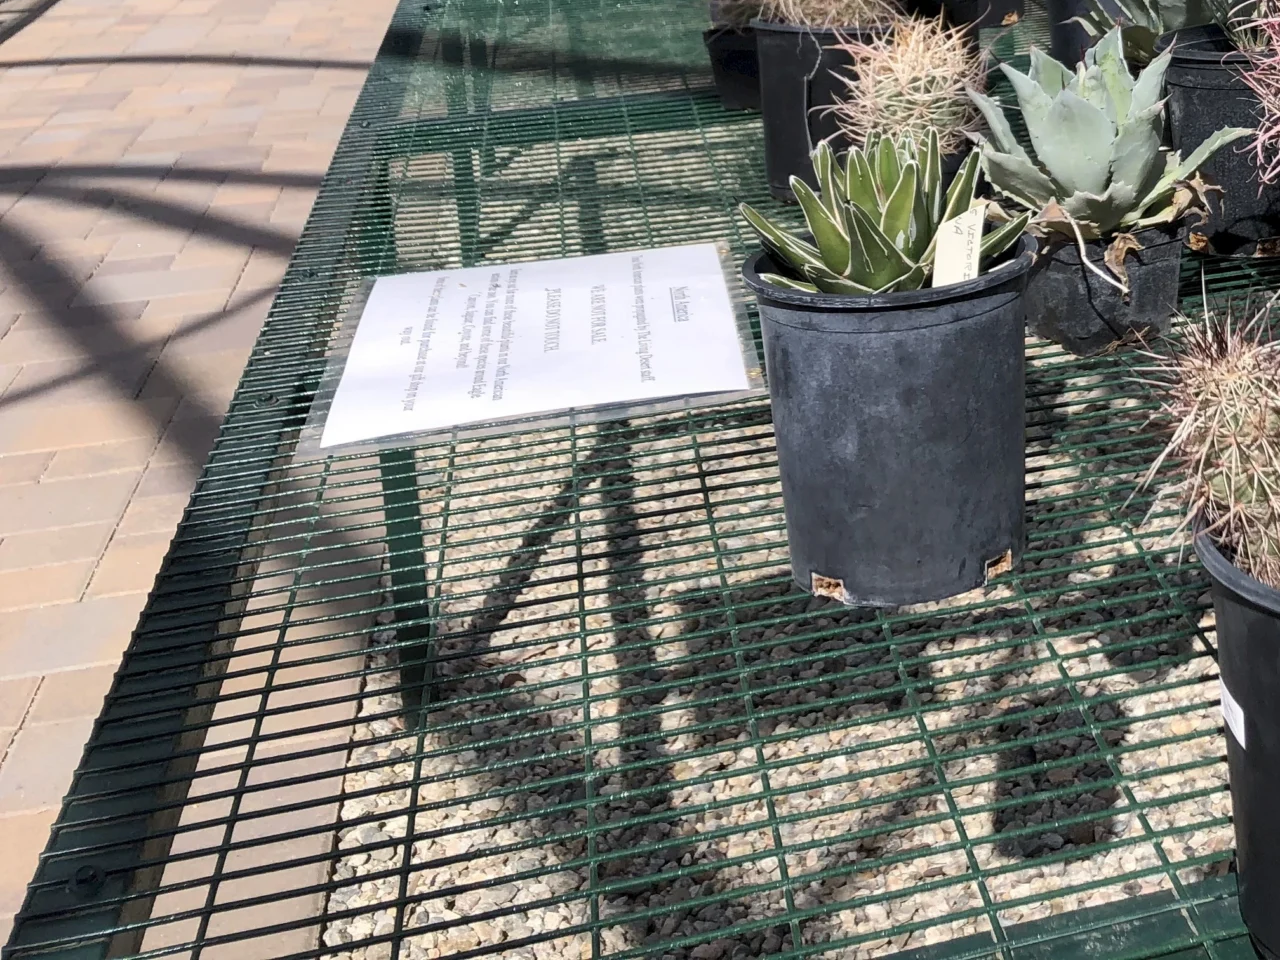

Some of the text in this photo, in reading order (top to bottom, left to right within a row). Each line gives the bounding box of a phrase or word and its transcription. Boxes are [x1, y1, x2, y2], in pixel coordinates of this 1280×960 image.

[672, 286, 692, 322] North America
[545, 309, 561, 318] DO
[590, 284, 607, 345] WE ARE NOT FOR SALE.
[545, 317, 560, 330] NOT
[638, 330, 651, 340] The
[635, 339, 651, 354] Living
[639, 354, 653, 369] Desert
[495, 364, 510, 377] North
[467, 384, 486, 398] Eagle
[492, 378, 508, 400] American
